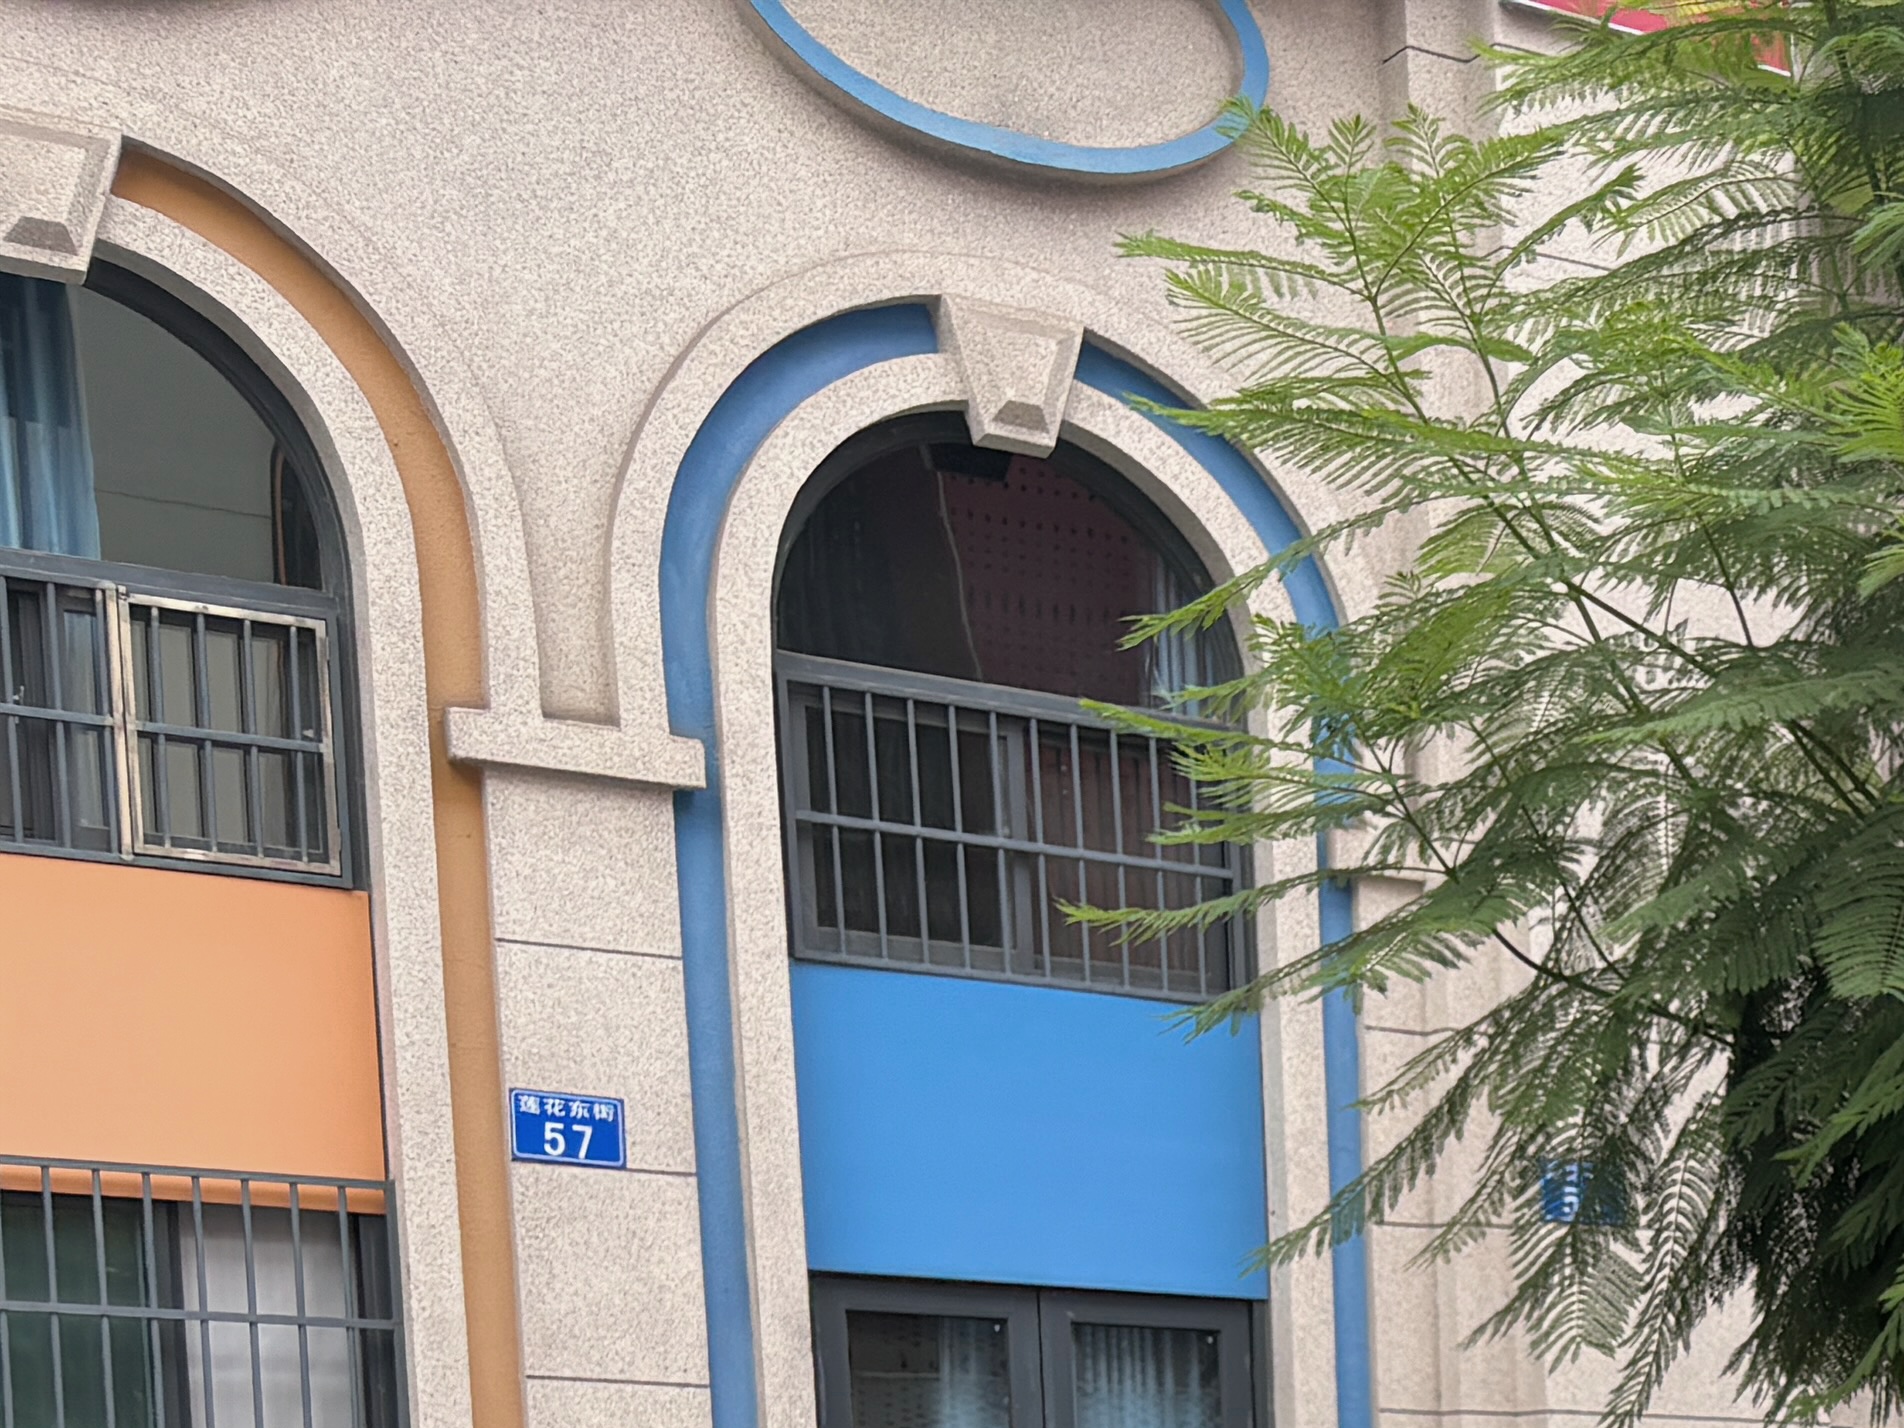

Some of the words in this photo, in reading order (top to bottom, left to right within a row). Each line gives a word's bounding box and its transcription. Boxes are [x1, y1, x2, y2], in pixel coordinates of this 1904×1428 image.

[517, 1094, 615, 1122] 莲花东街
[543, 1121, 594, 1160] 57
